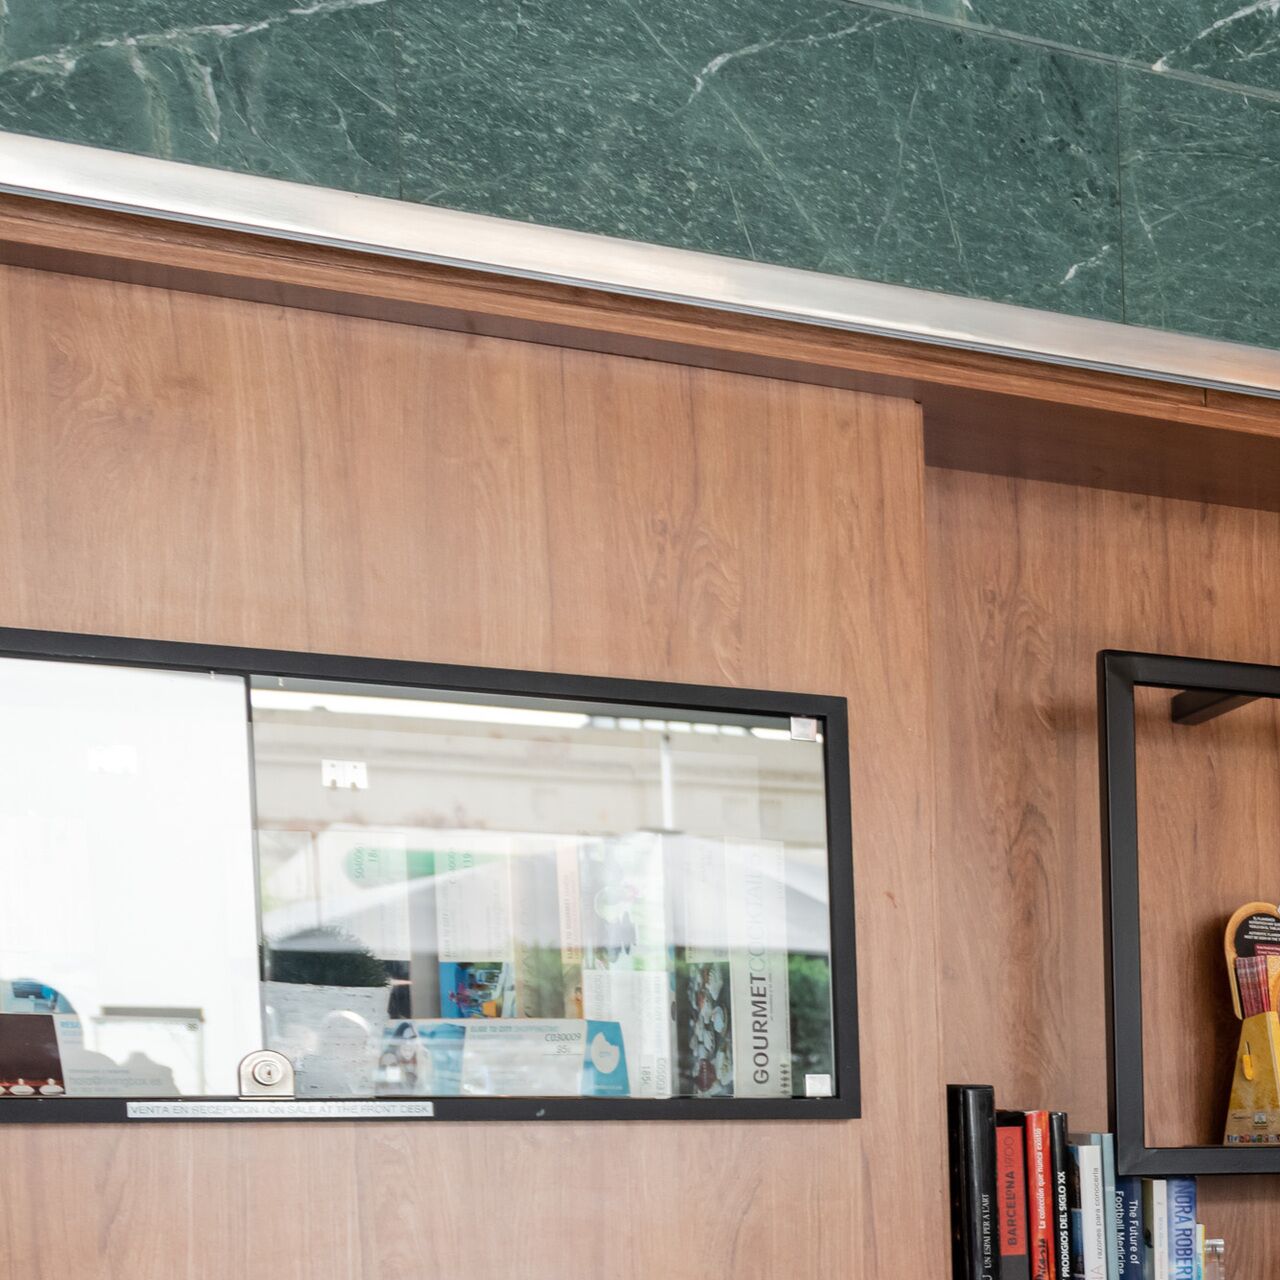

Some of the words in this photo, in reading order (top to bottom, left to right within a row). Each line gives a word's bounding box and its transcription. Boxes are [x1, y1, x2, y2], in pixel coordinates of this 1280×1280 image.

[750, 972, 770, 1085] GOURMET
[1057, 1170, 1066, 1184] XX
[1058, 1184, 1069, 1211] SIGLO
[1115, 1190, 1124, 1231] Football
[1128, 1199, 1138, 1217] The
[1173, 1183, 1193, 1225] NORA
[1059, 1211, 1069, 1228] DEL
[1129, 1218, 1140, 1253] Future
[1060, 1228, 1072, 1275] PRODIGIOS
[1116, 1231, 1124, 1275] Medicine
[1130, 1253, 1140, 1265] of
